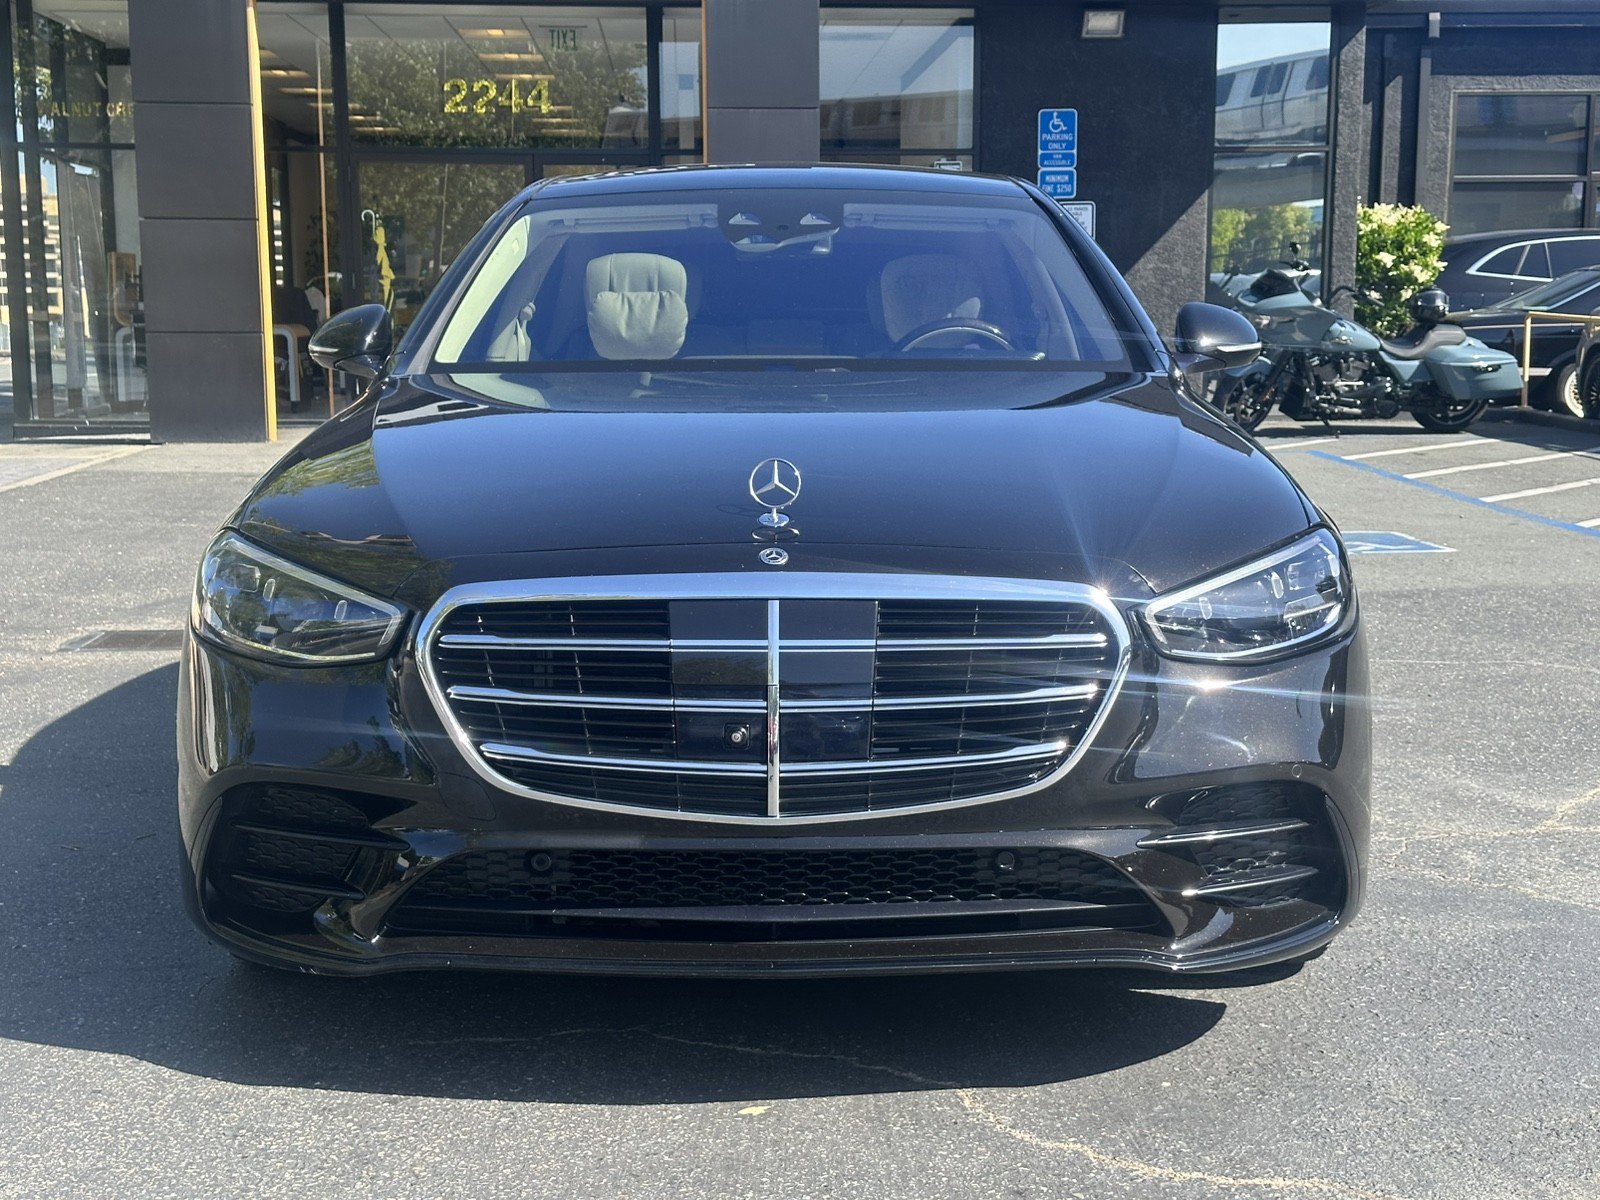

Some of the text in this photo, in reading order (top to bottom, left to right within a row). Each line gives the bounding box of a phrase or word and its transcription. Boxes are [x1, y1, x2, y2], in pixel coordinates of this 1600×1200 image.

[443, 78, 551, 114] 2244
[1042, 133, 1073, 141] PARKING
[1048, 142, 1067, 150] ONLY
[1045, 175, 1069, 183] MINIMUM
